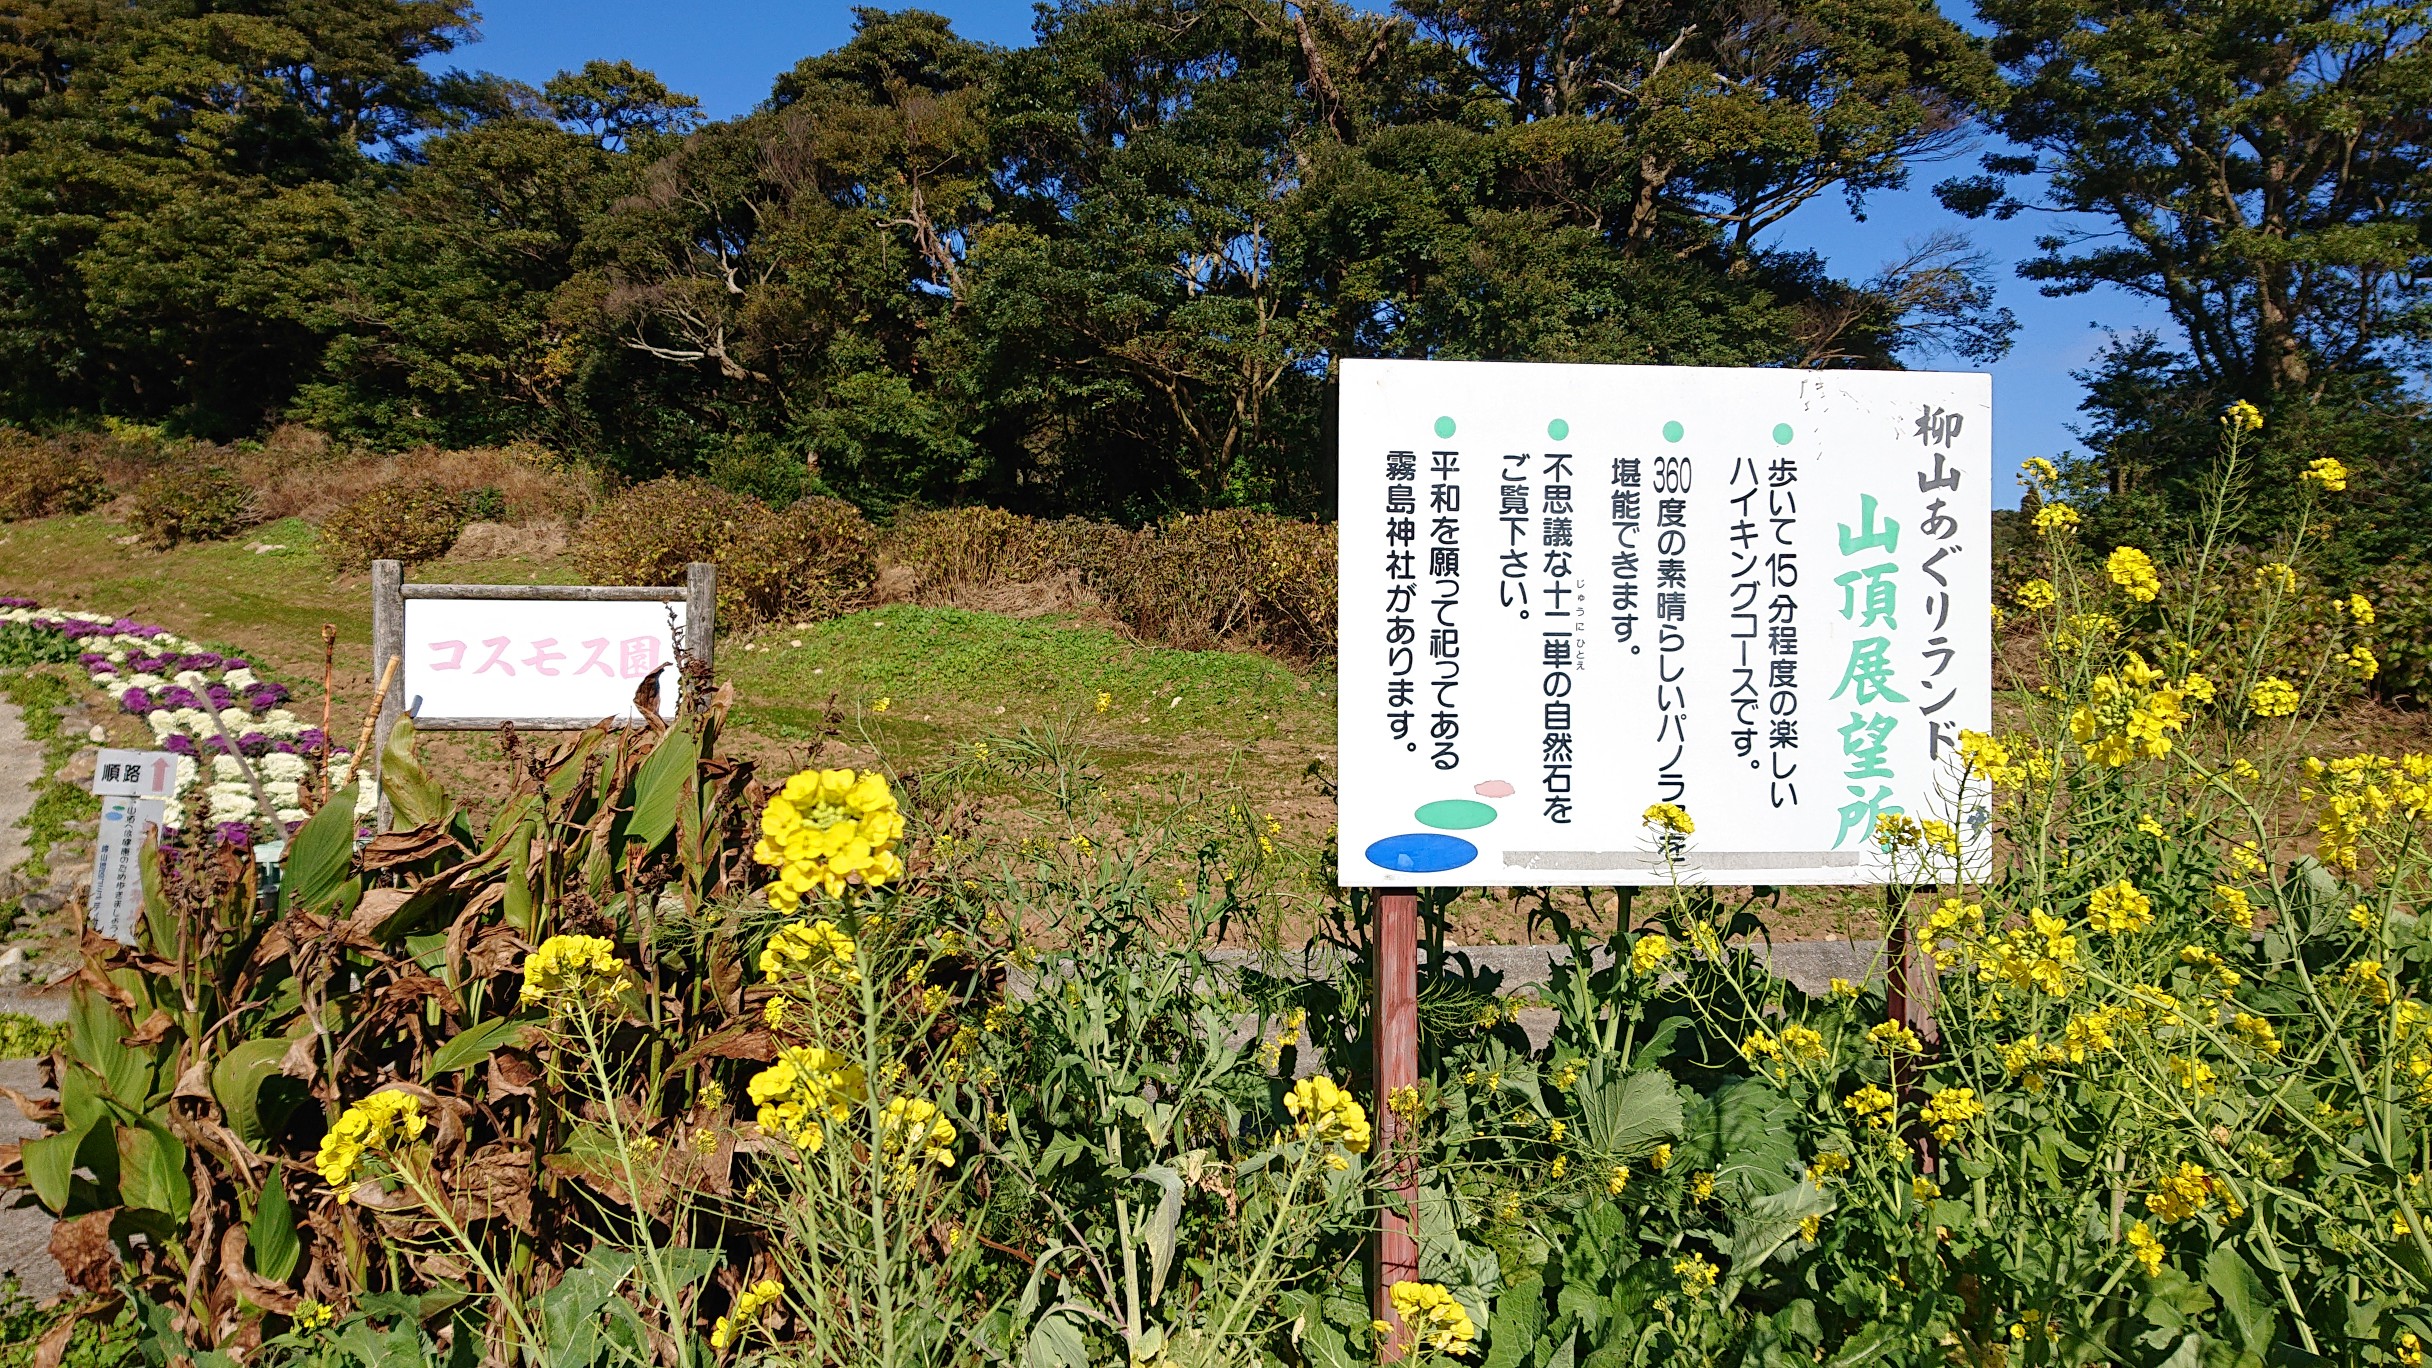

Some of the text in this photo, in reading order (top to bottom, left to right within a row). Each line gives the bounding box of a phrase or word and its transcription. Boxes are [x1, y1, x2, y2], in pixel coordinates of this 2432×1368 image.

[428, 635, 661, 679] コスモス園
[1386, 450, 1418, 753] 霧島神社があります。
[1430, 450, 1460, 771] 平和を願って祀ってある
[1499, 453, 1531, 622] ご覧下さい。
[1542, 453, 1573, 824] 不思議な十二単の自然石を
[1611, 457, 1642, 656] 堪能できます。
[1653, 456, 1692, 862] 360度の素晴らしいパノラを
[1729, 457, 1762, 770] ハイキングコースです。
[1765, 457, 1799, 809] 歩いて15分程度の楽しい
[1829, 493, 1910, 855] 山頂展望所
[1914, 404, 1963, 762] 柳山あぐりランド
[101, 763, 142, 783] 順路
